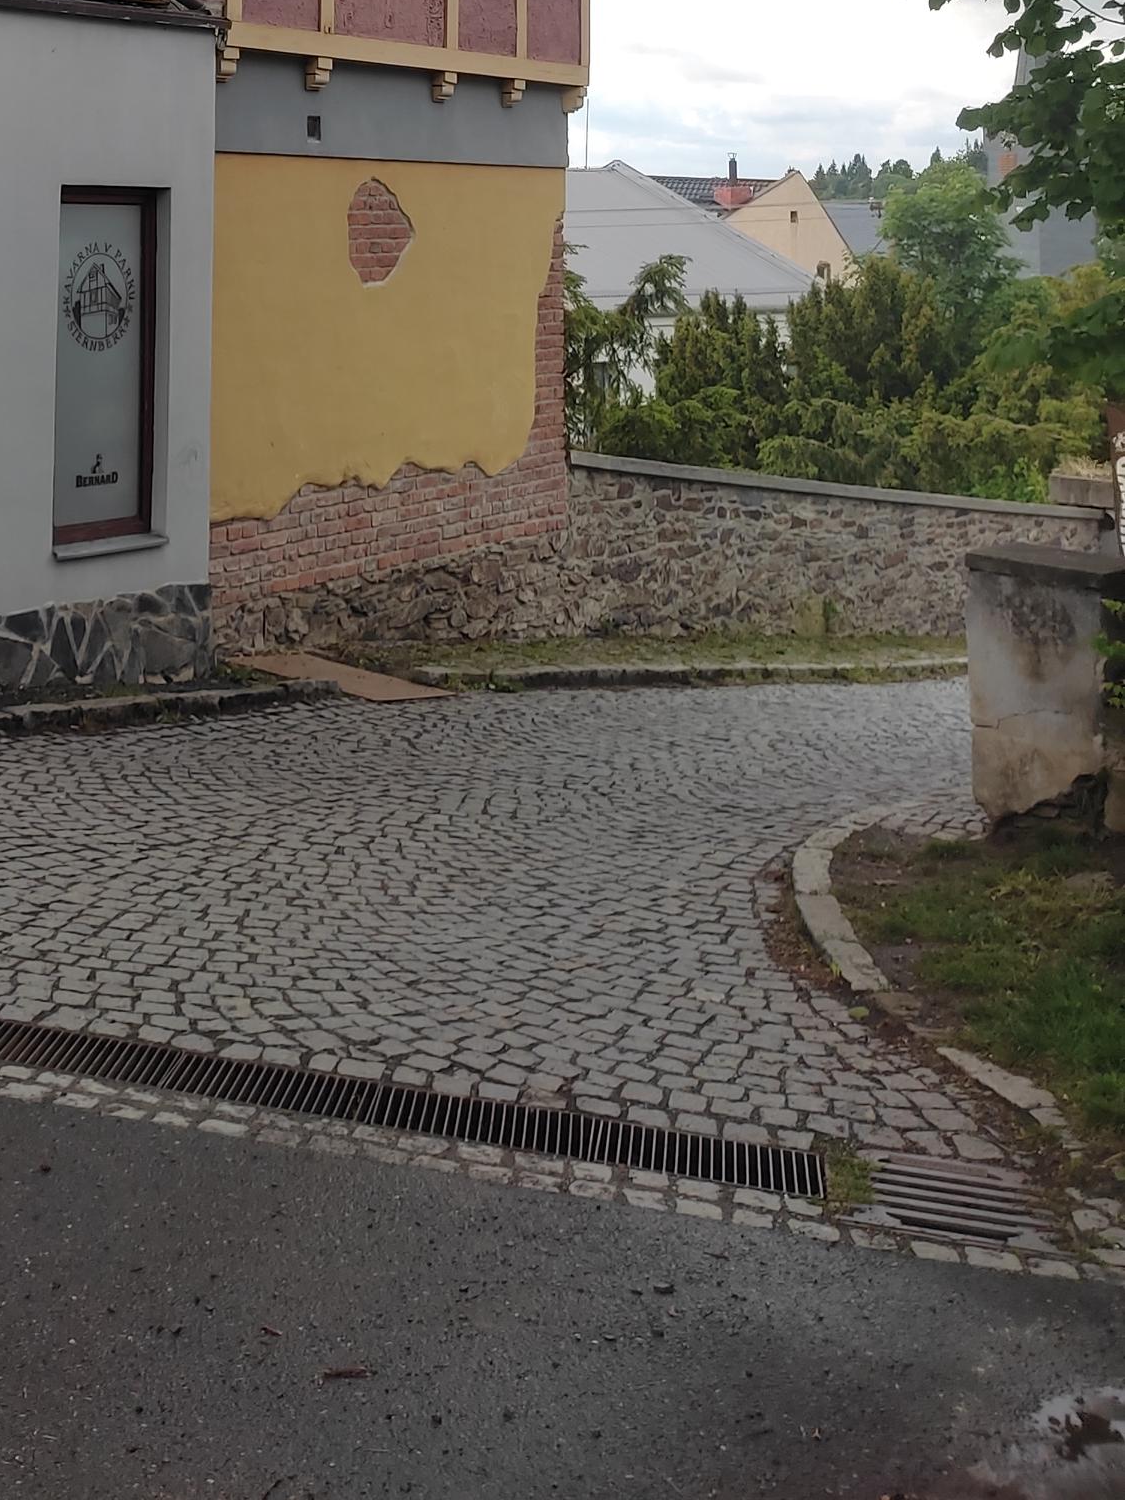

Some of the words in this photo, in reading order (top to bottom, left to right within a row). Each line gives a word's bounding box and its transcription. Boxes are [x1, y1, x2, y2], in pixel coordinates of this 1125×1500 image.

[104, 242, 112, 253] V
[115, 249, 135, 300] PARKU
[75, 471, 118, 488] BERNARD
